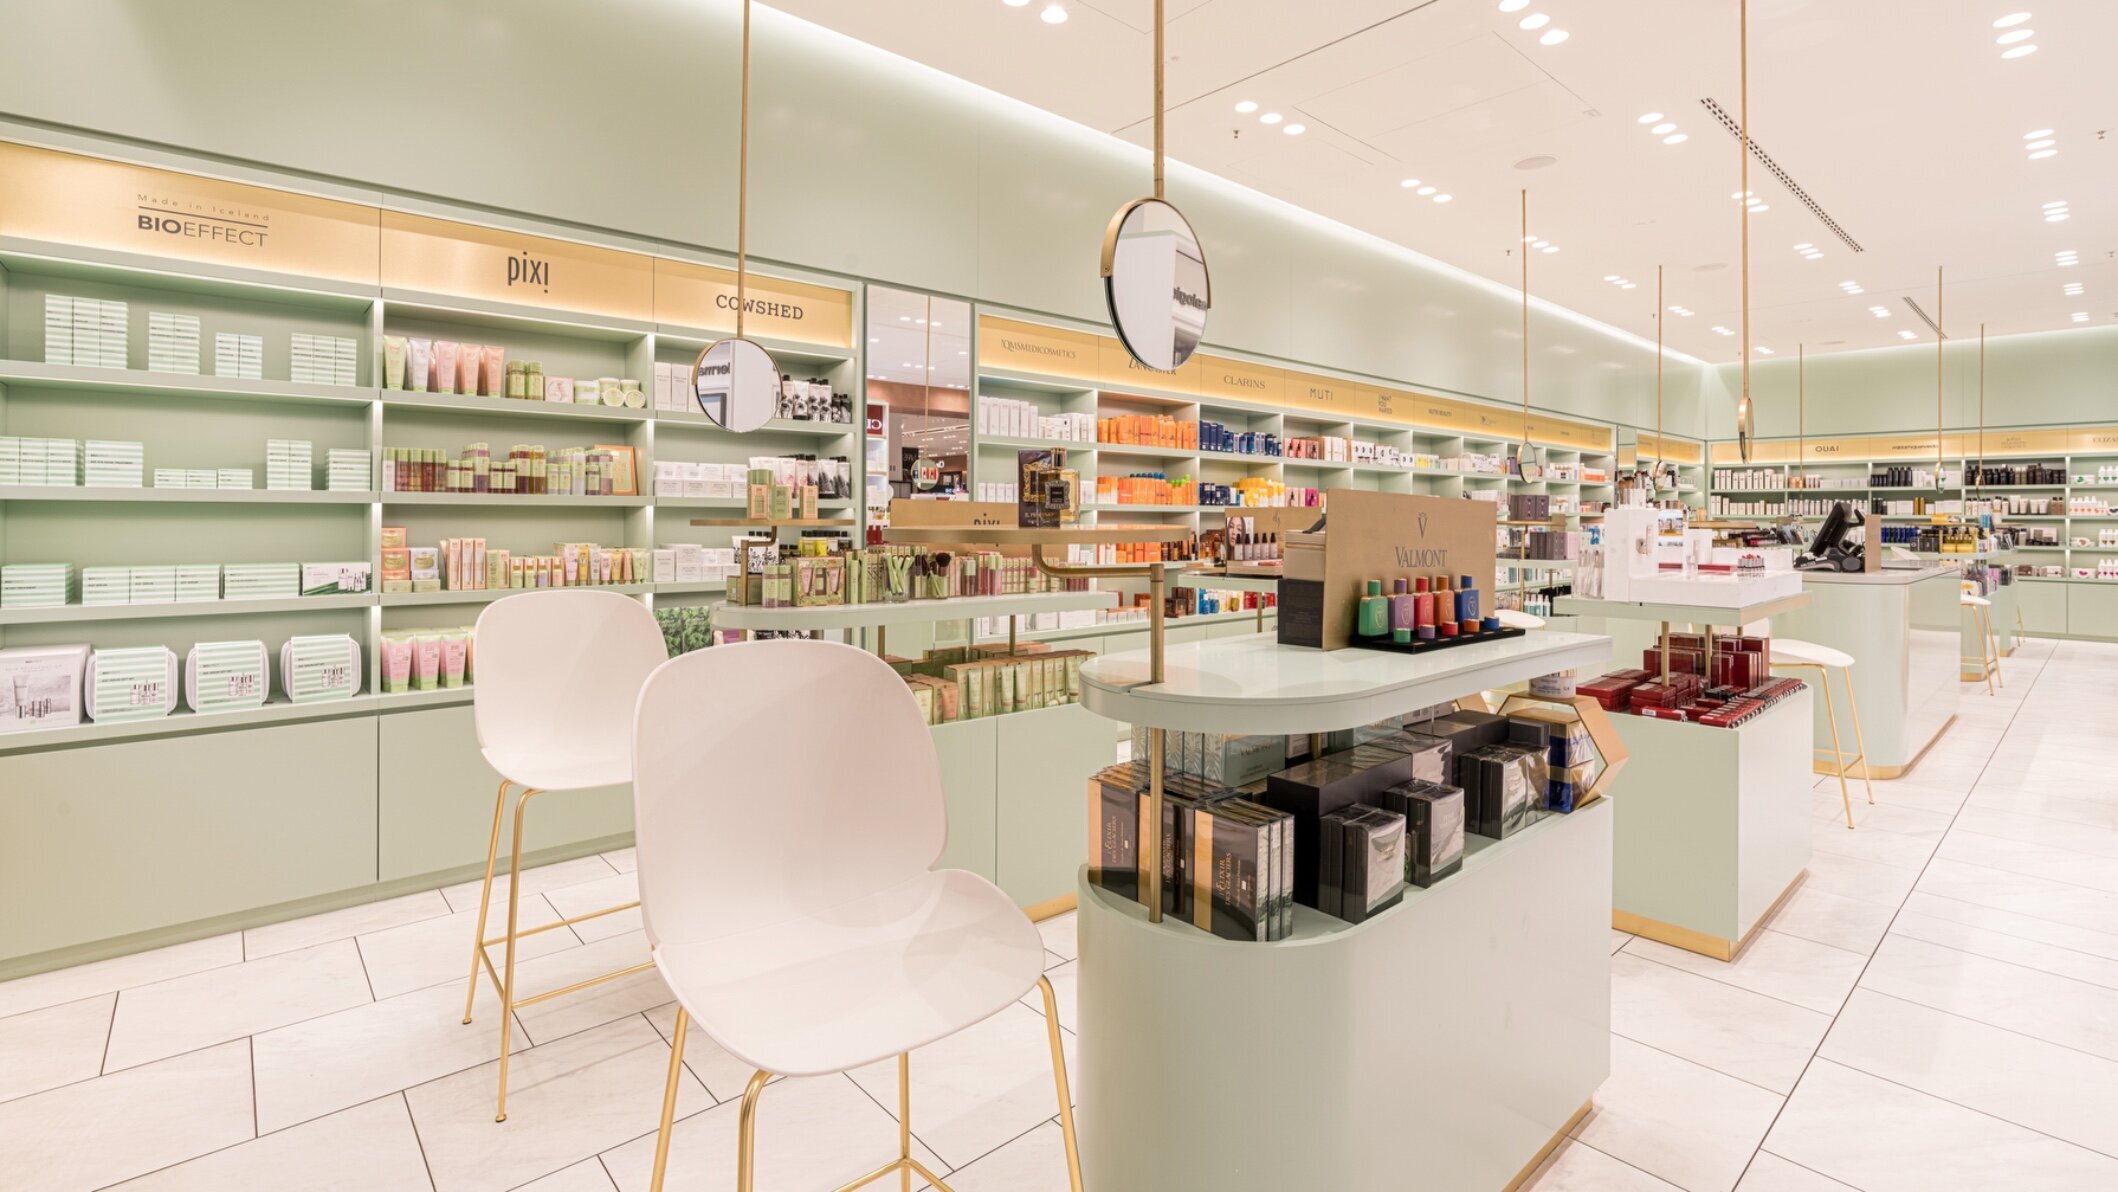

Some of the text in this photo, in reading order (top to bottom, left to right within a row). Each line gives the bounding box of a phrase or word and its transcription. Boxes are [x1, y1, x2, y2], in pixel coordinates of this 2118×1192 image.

[137, 193, 270, 221] Made in Iceland
[137, 214, 268, 247] BIOEFFECT
[508, 251, 549, 294] pixi
[716, 294, 804, 320] COWSHED
[1223, 374, 1266, 390] CLARINS
[1309, 387, 1334, 401] MUTI
[1814, 445, 1840, 453] OUAI
[1395, 546, 1448, 568] VALMONT
